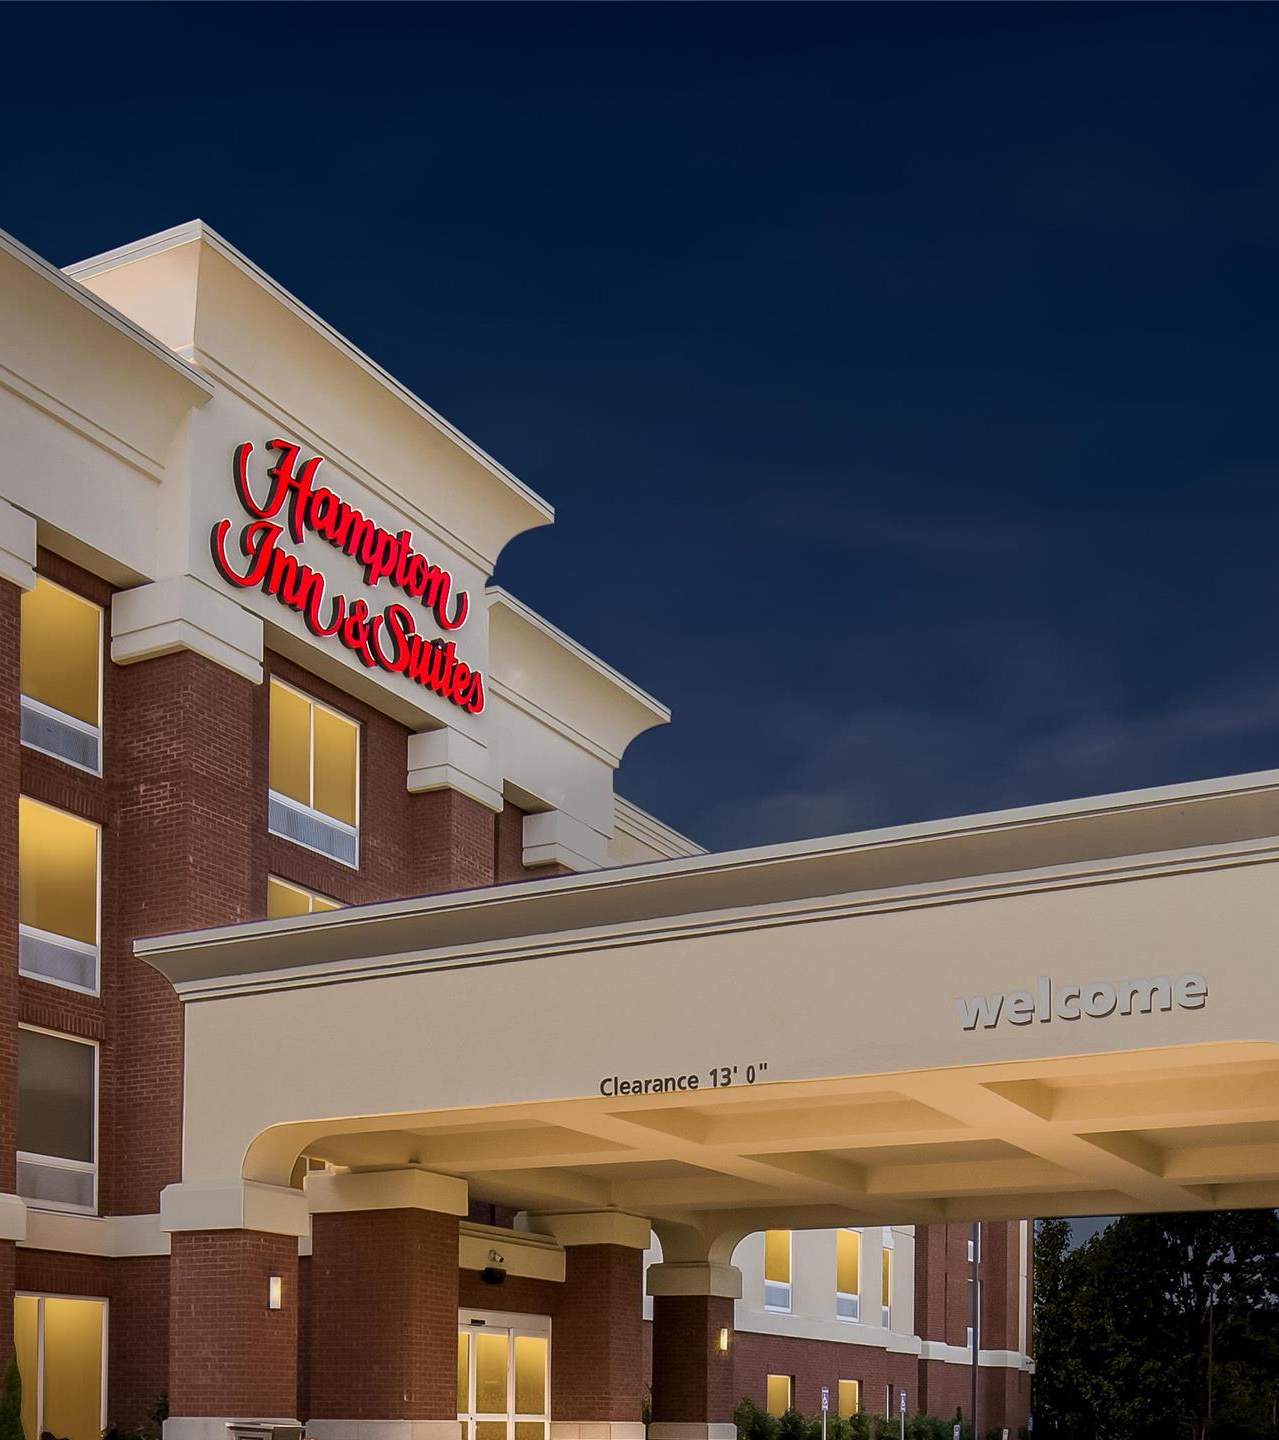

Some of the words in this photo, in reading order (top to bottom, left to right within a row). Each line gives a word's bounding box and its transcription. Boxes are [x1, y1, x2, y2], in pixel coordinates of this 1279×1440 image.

[233, 438, 468, 630] Hampton
[210, 518, 346, 637] Inn
[338, 599, 378, 667] &
[368, 603, 484, 714] Suites
[955, 974, 1209, 1031] welcome
[600, 1074, 699, 1096] Clearance
